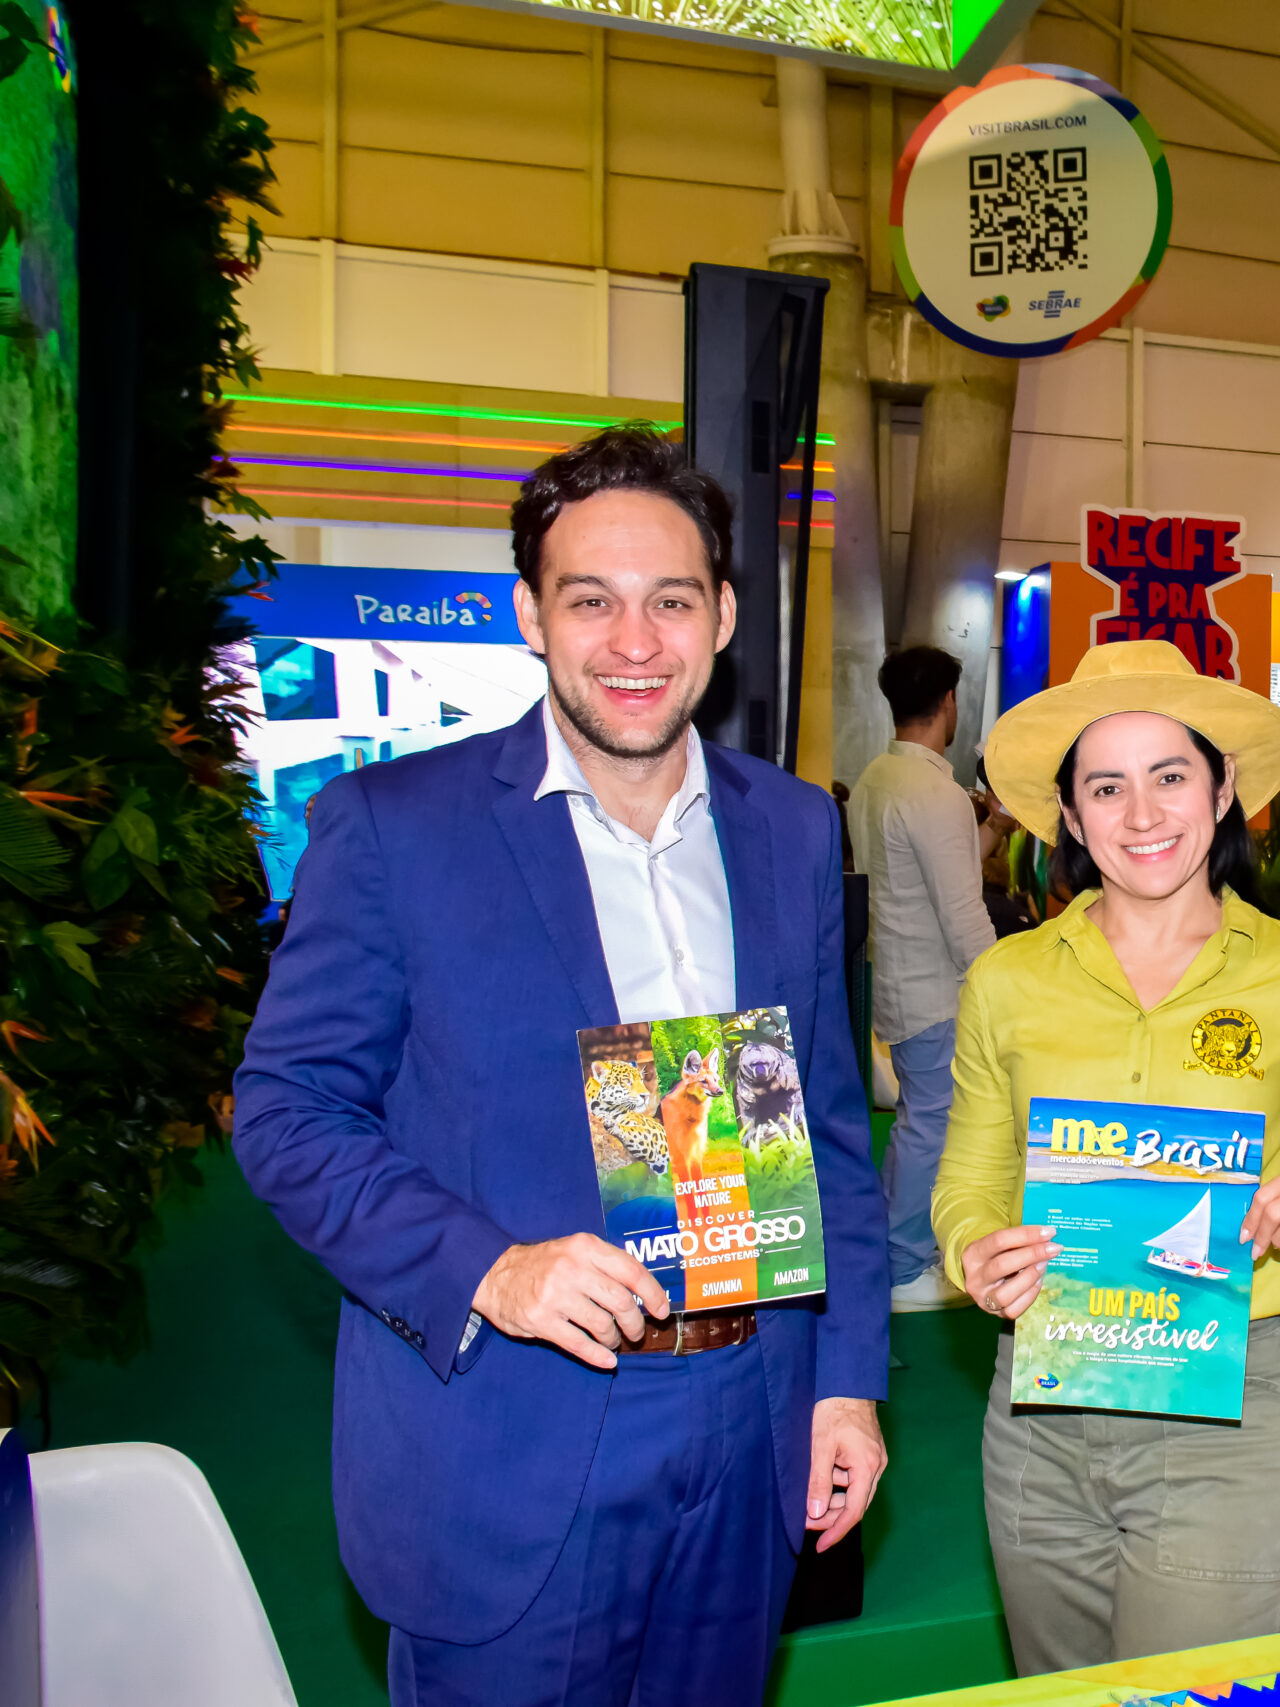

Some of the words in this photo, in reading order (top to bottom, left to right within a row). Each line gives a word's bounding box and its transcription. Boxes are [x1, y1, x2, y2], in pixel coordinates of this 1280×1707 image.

[969, 115, 1086, 136] VISITBRASIL.COM
[1029, 297, 1081, 311] SEBRAE
[1087, 510, 1241, 573] RECIFE
[1120, 572, 1139, 617] É
[1148, 581, 1212, 619] PRA
[1197, 1010, 1258, 1034] PANTANAL
[1195, 1047, 1257, 1070] EXPLORER
[1130, 1130, 1248, 1175] Brasil
[675, 1177, 717, 1196] EXPLORE
[719, 1174, 746, 1190] YOUR
[694, 1191, 732, 1208] NATURE
[677, 1210, 755, 1229] DISCOVER
[624, 1230, 699, 1264] MATO
[704, 1215, 806, 1252] GROSSO
[680, 1260, 688, 1269] 3
[702, 1278, 742, 1297] SAVANNA
[774, 1268, 809, 1286] AMAZON
[1089, 1288, 1125, 1317] UM
[1128, 1287, 1181, 1321] PAÍS
[1045, 1315, 1220, 1351] irresistível
